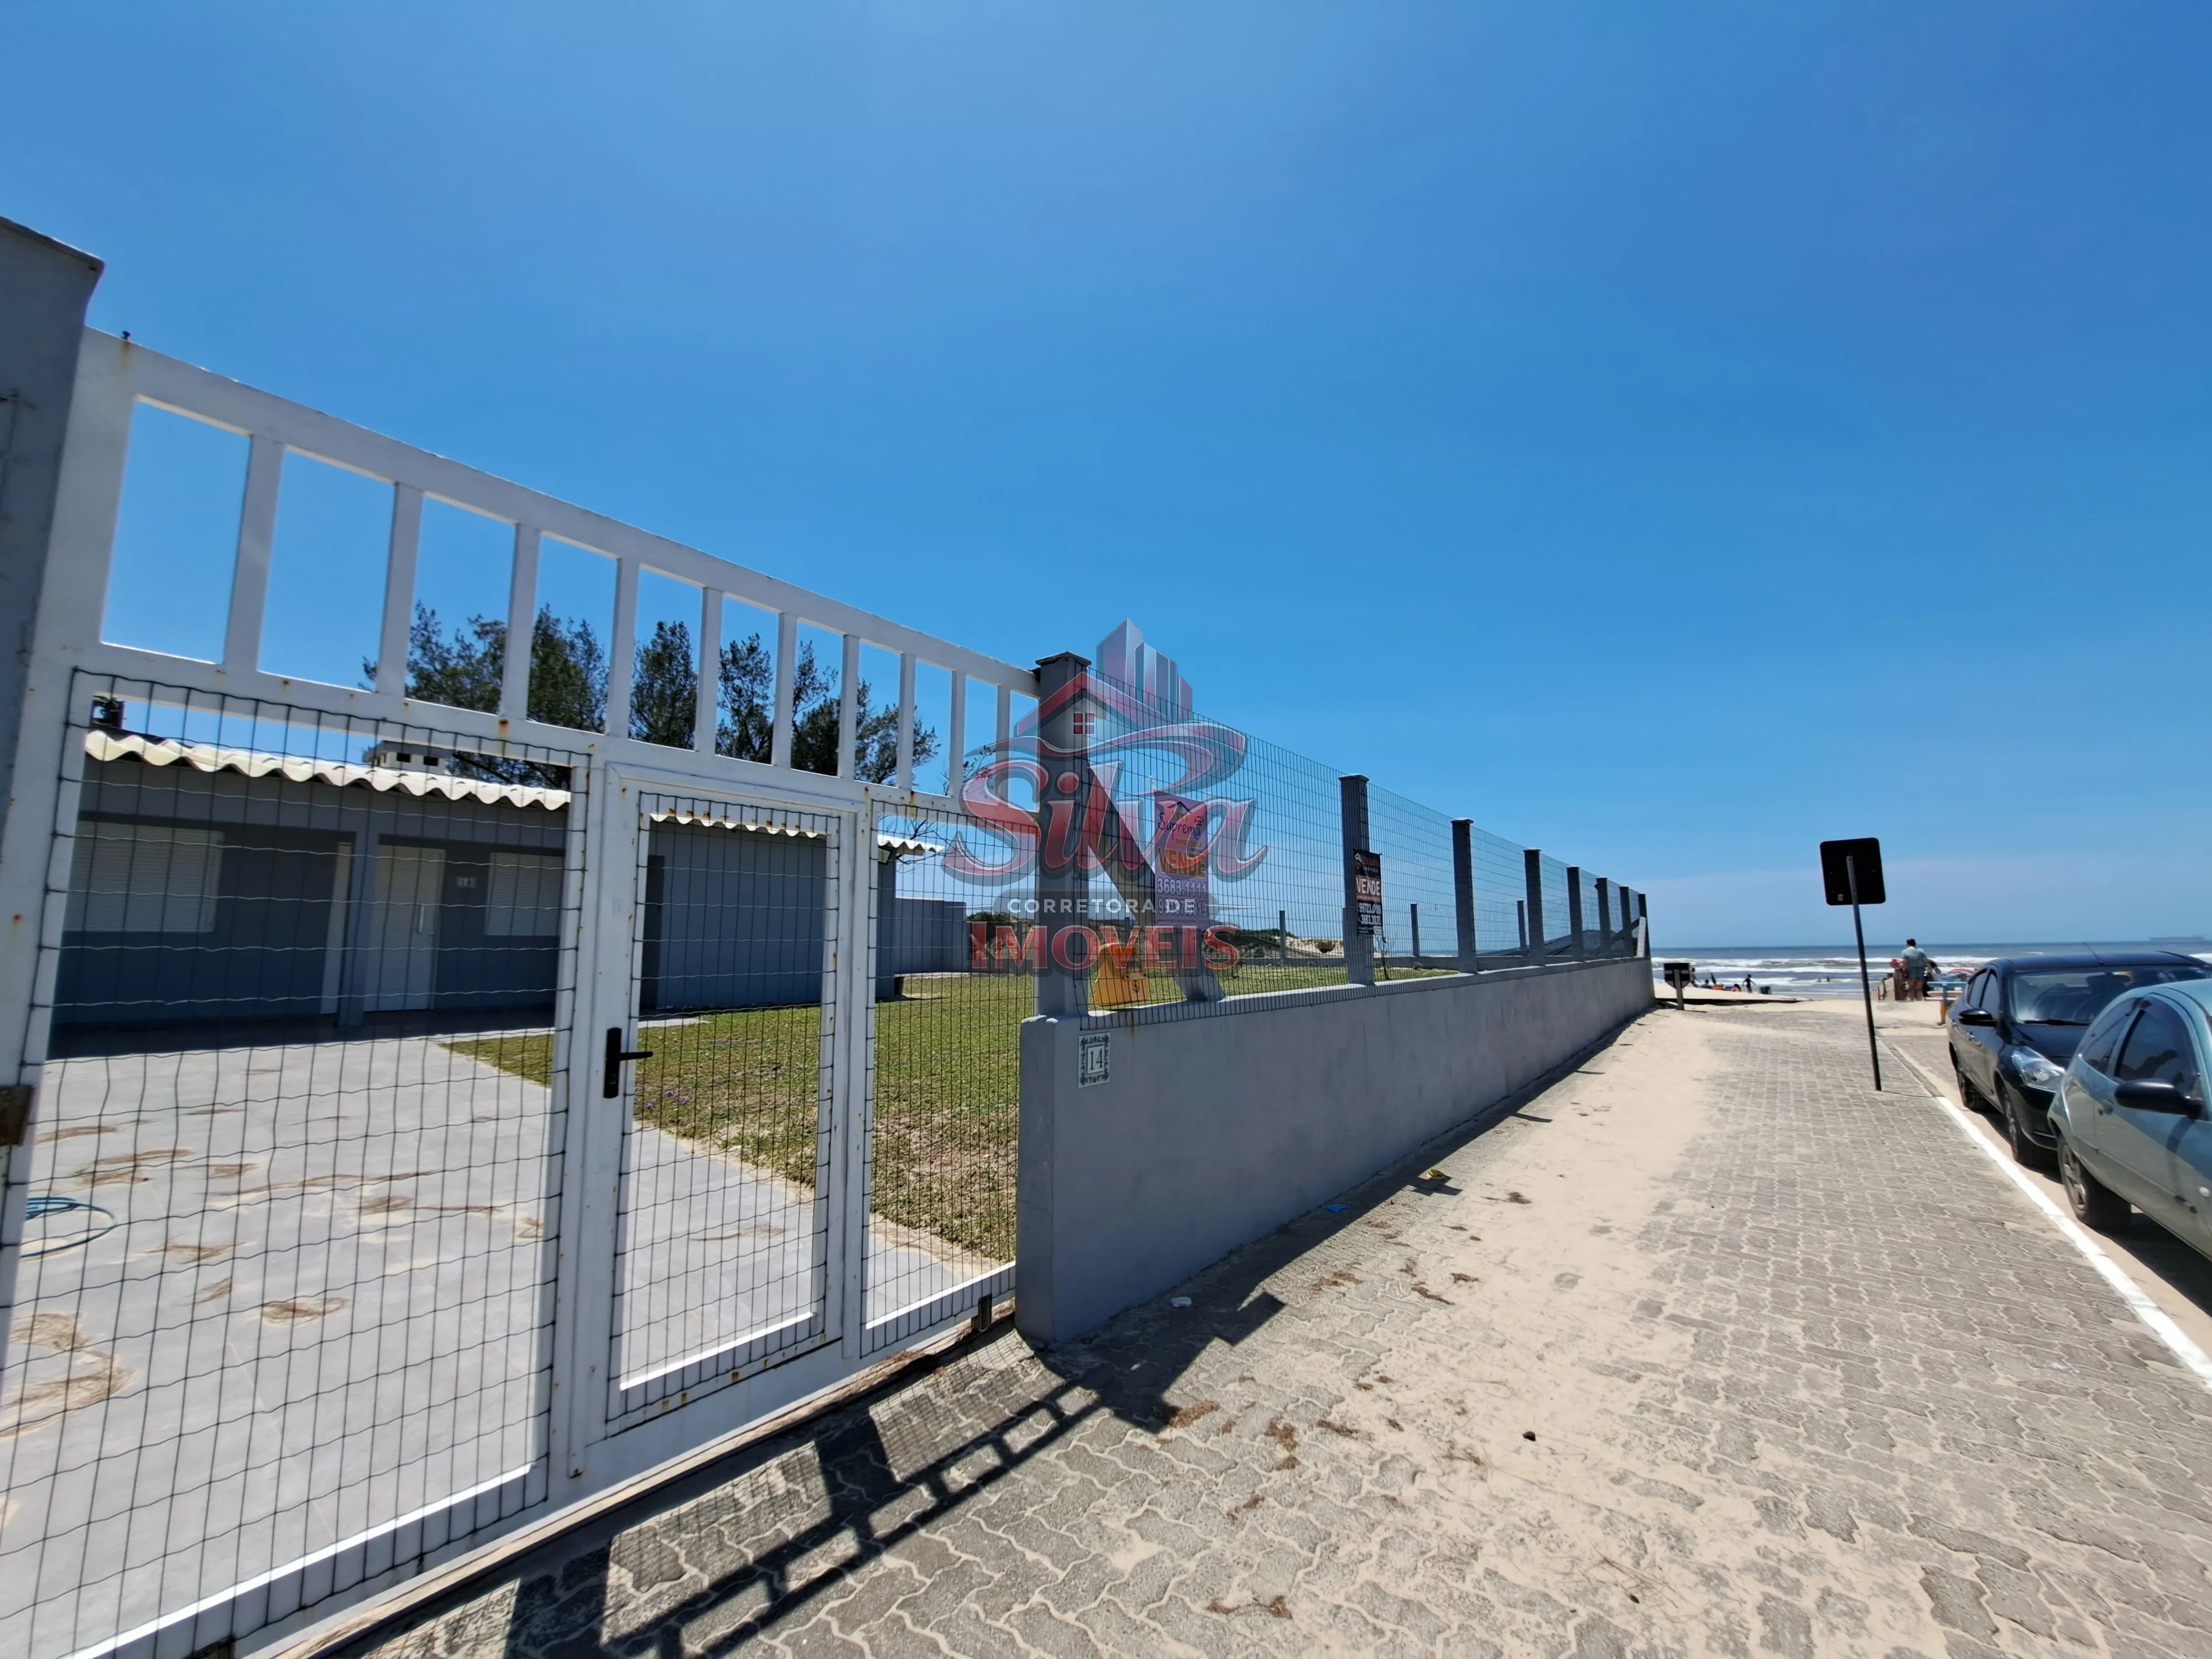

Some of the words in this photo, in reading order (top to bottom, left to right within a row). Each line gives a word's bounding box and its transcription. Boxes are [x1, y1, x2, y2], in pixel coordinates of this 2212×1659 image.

[1157, 847, 1206, 878] VENDE
[1157, 877, 1207, 897] 3683.1111
[1355, 877, 1381, 896] VENDE
[1090, 1048, 1103, 1070] 14
